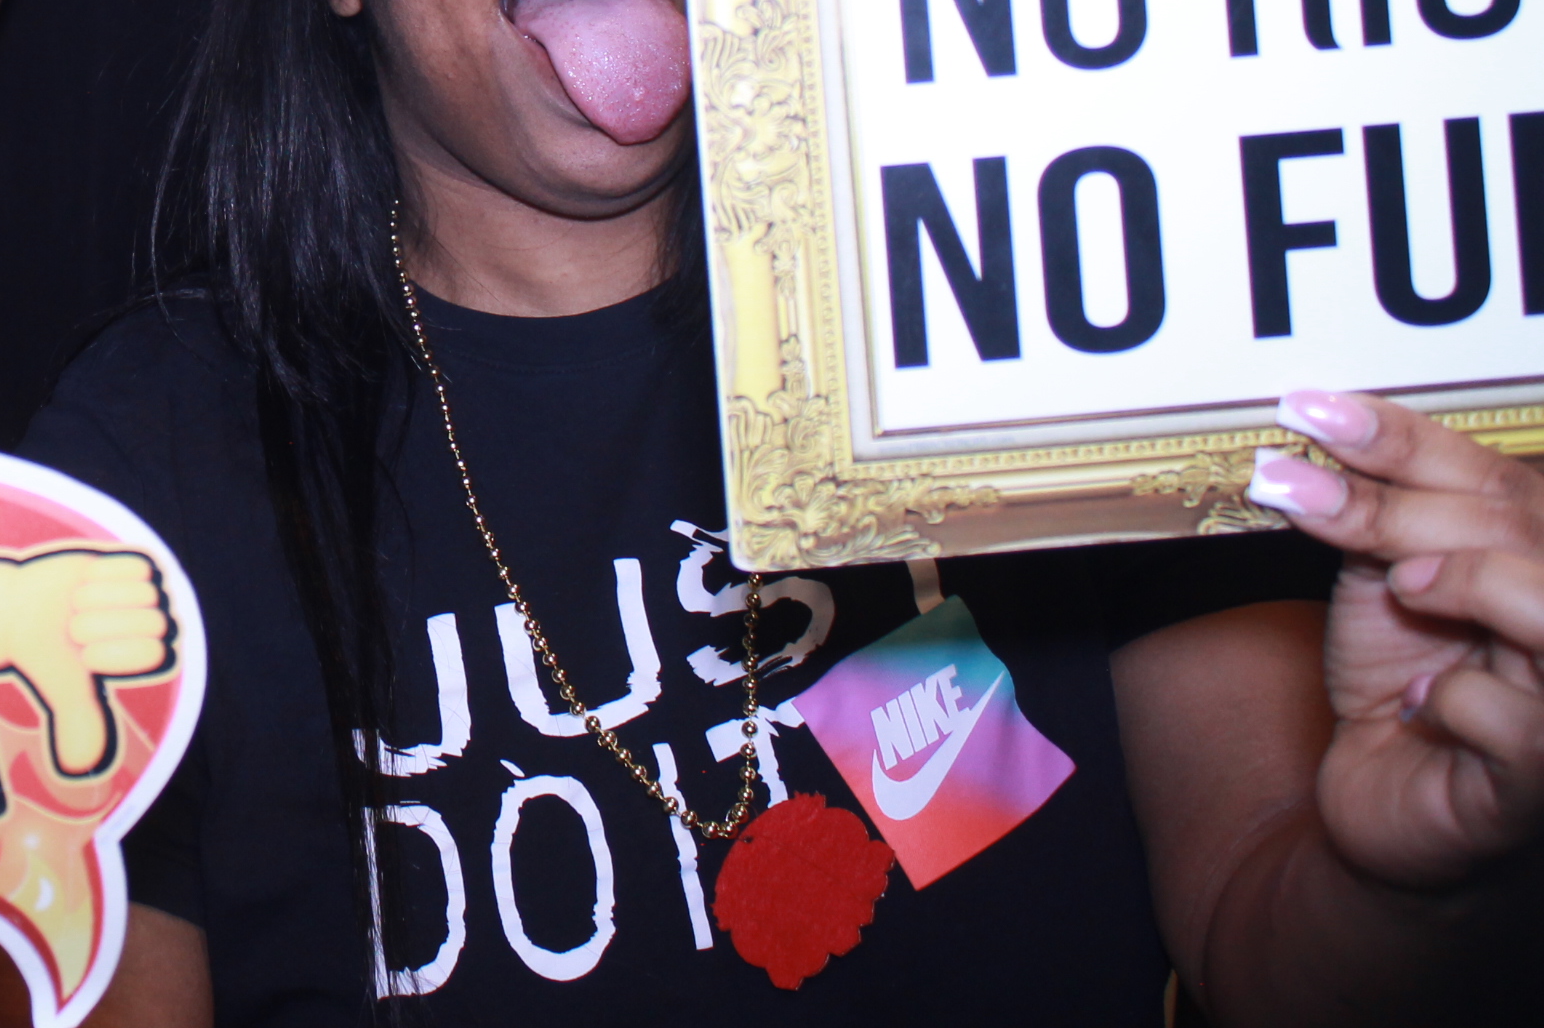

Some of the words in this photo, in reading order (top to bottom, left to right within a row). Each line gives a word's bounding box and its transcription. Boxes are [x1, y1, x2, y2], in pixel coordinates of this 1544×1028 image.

[879, 145, 1166, 369] NO
[352, 519, 946, 777] JUS
[870, 663, 972, 771] NIKE
[360, 760, 616, 1001] DO
